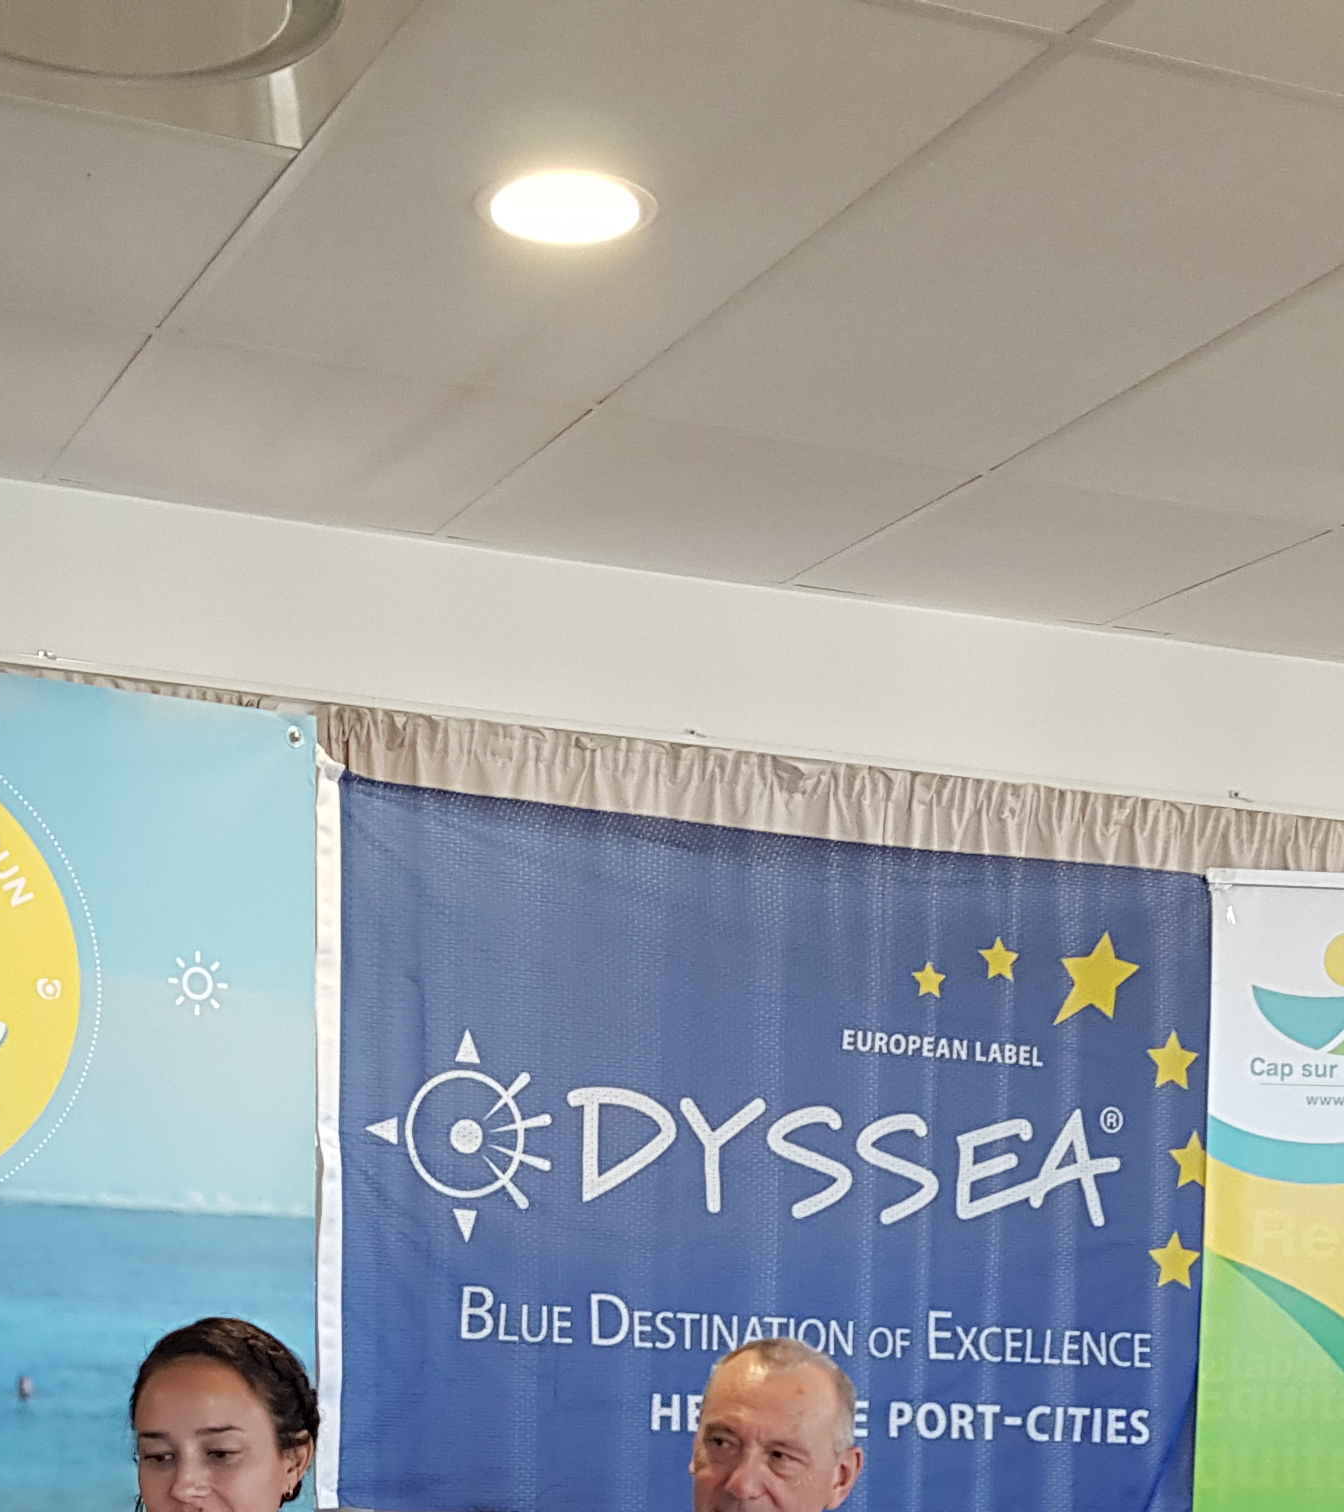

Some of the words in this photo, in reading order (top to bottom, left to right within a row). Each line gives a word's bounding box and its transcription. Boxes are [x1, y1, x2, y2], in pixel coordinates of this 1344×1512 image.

[842, 1028, 968, 1061] EUROPEAN
[975, 1041, 1044, 1067] LABEL
[1250, 1057, 1294, 1081] Cap
[1301, 1063, 1338, 1079] sur
[888, 1403, 1150, 1445] PORT-CITIES
